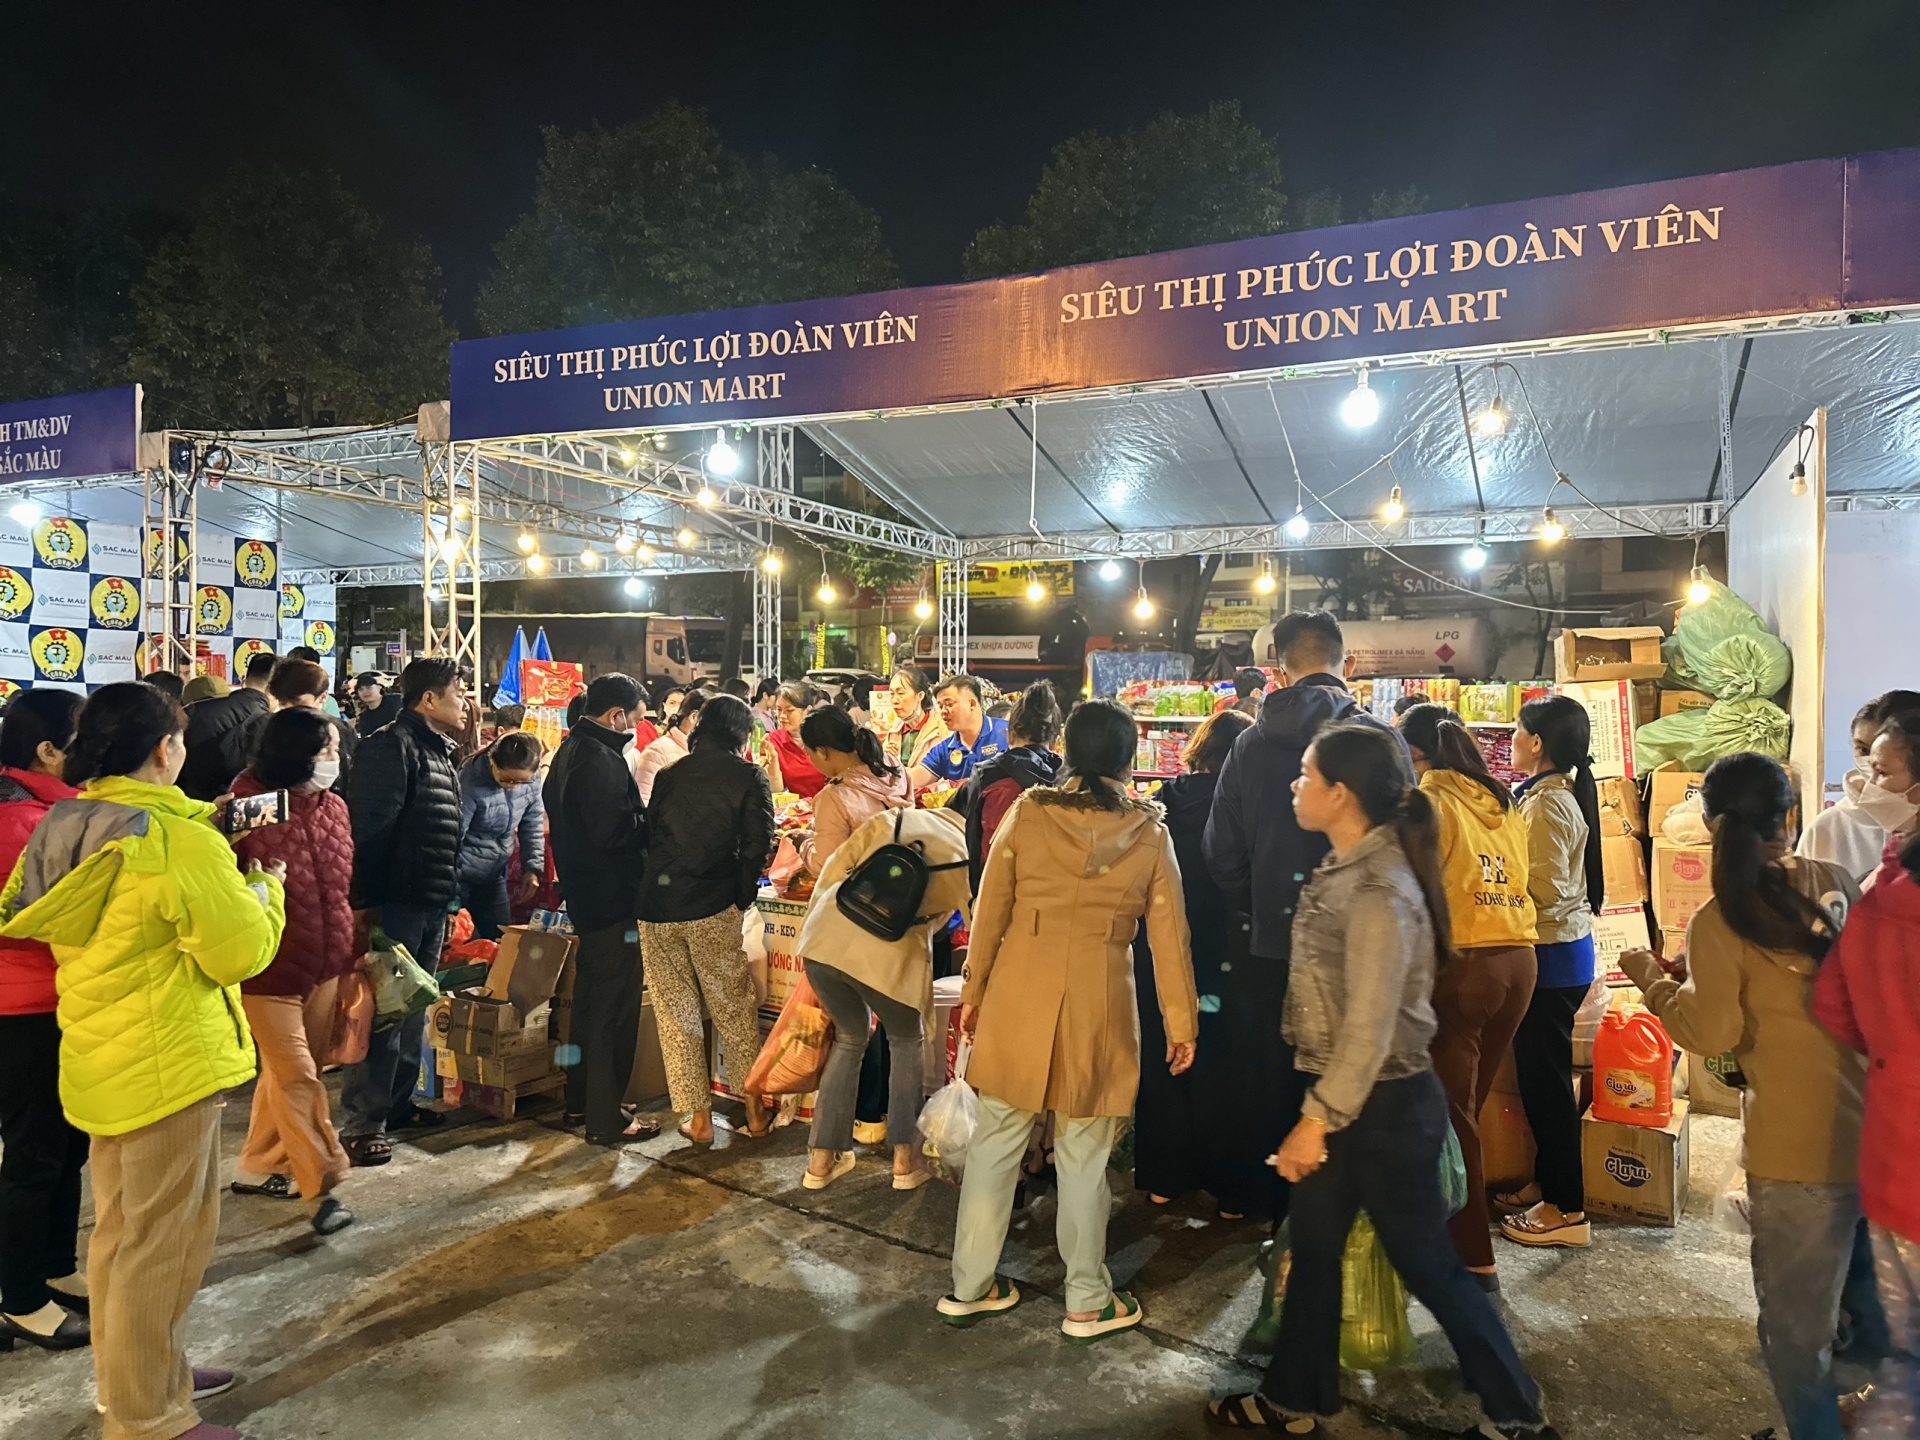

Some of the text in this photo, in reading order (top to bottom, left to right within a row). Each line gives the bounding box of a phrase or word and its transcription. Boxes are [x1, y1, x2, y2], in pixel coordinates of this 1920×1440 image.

[1060, 203, 1724, 323] SIÊU THỊ PHÚC LỢI ĐOÀN VIÊN
[1223, 288, 1508, 351] UNION MART
[494, 311, 919, 384] SIÊU THỊ PHÚC LỢI ĐOÀN VIÊN
[603, 372, 786, 413] UNION MART
[13, 414, 72, 441] TM&DV
[25, 445, 62, 472] MÀU
[102, 545, 119, 553] SAC
[1435, 630, 1460, 640] LPG
[1473, 891, 1507, 907] SDHE
[764, 922, 775, 935] NH
[767, 949, 792, 972] ƯƠNG
[1604, 1156, 1654, 1182] Clara
